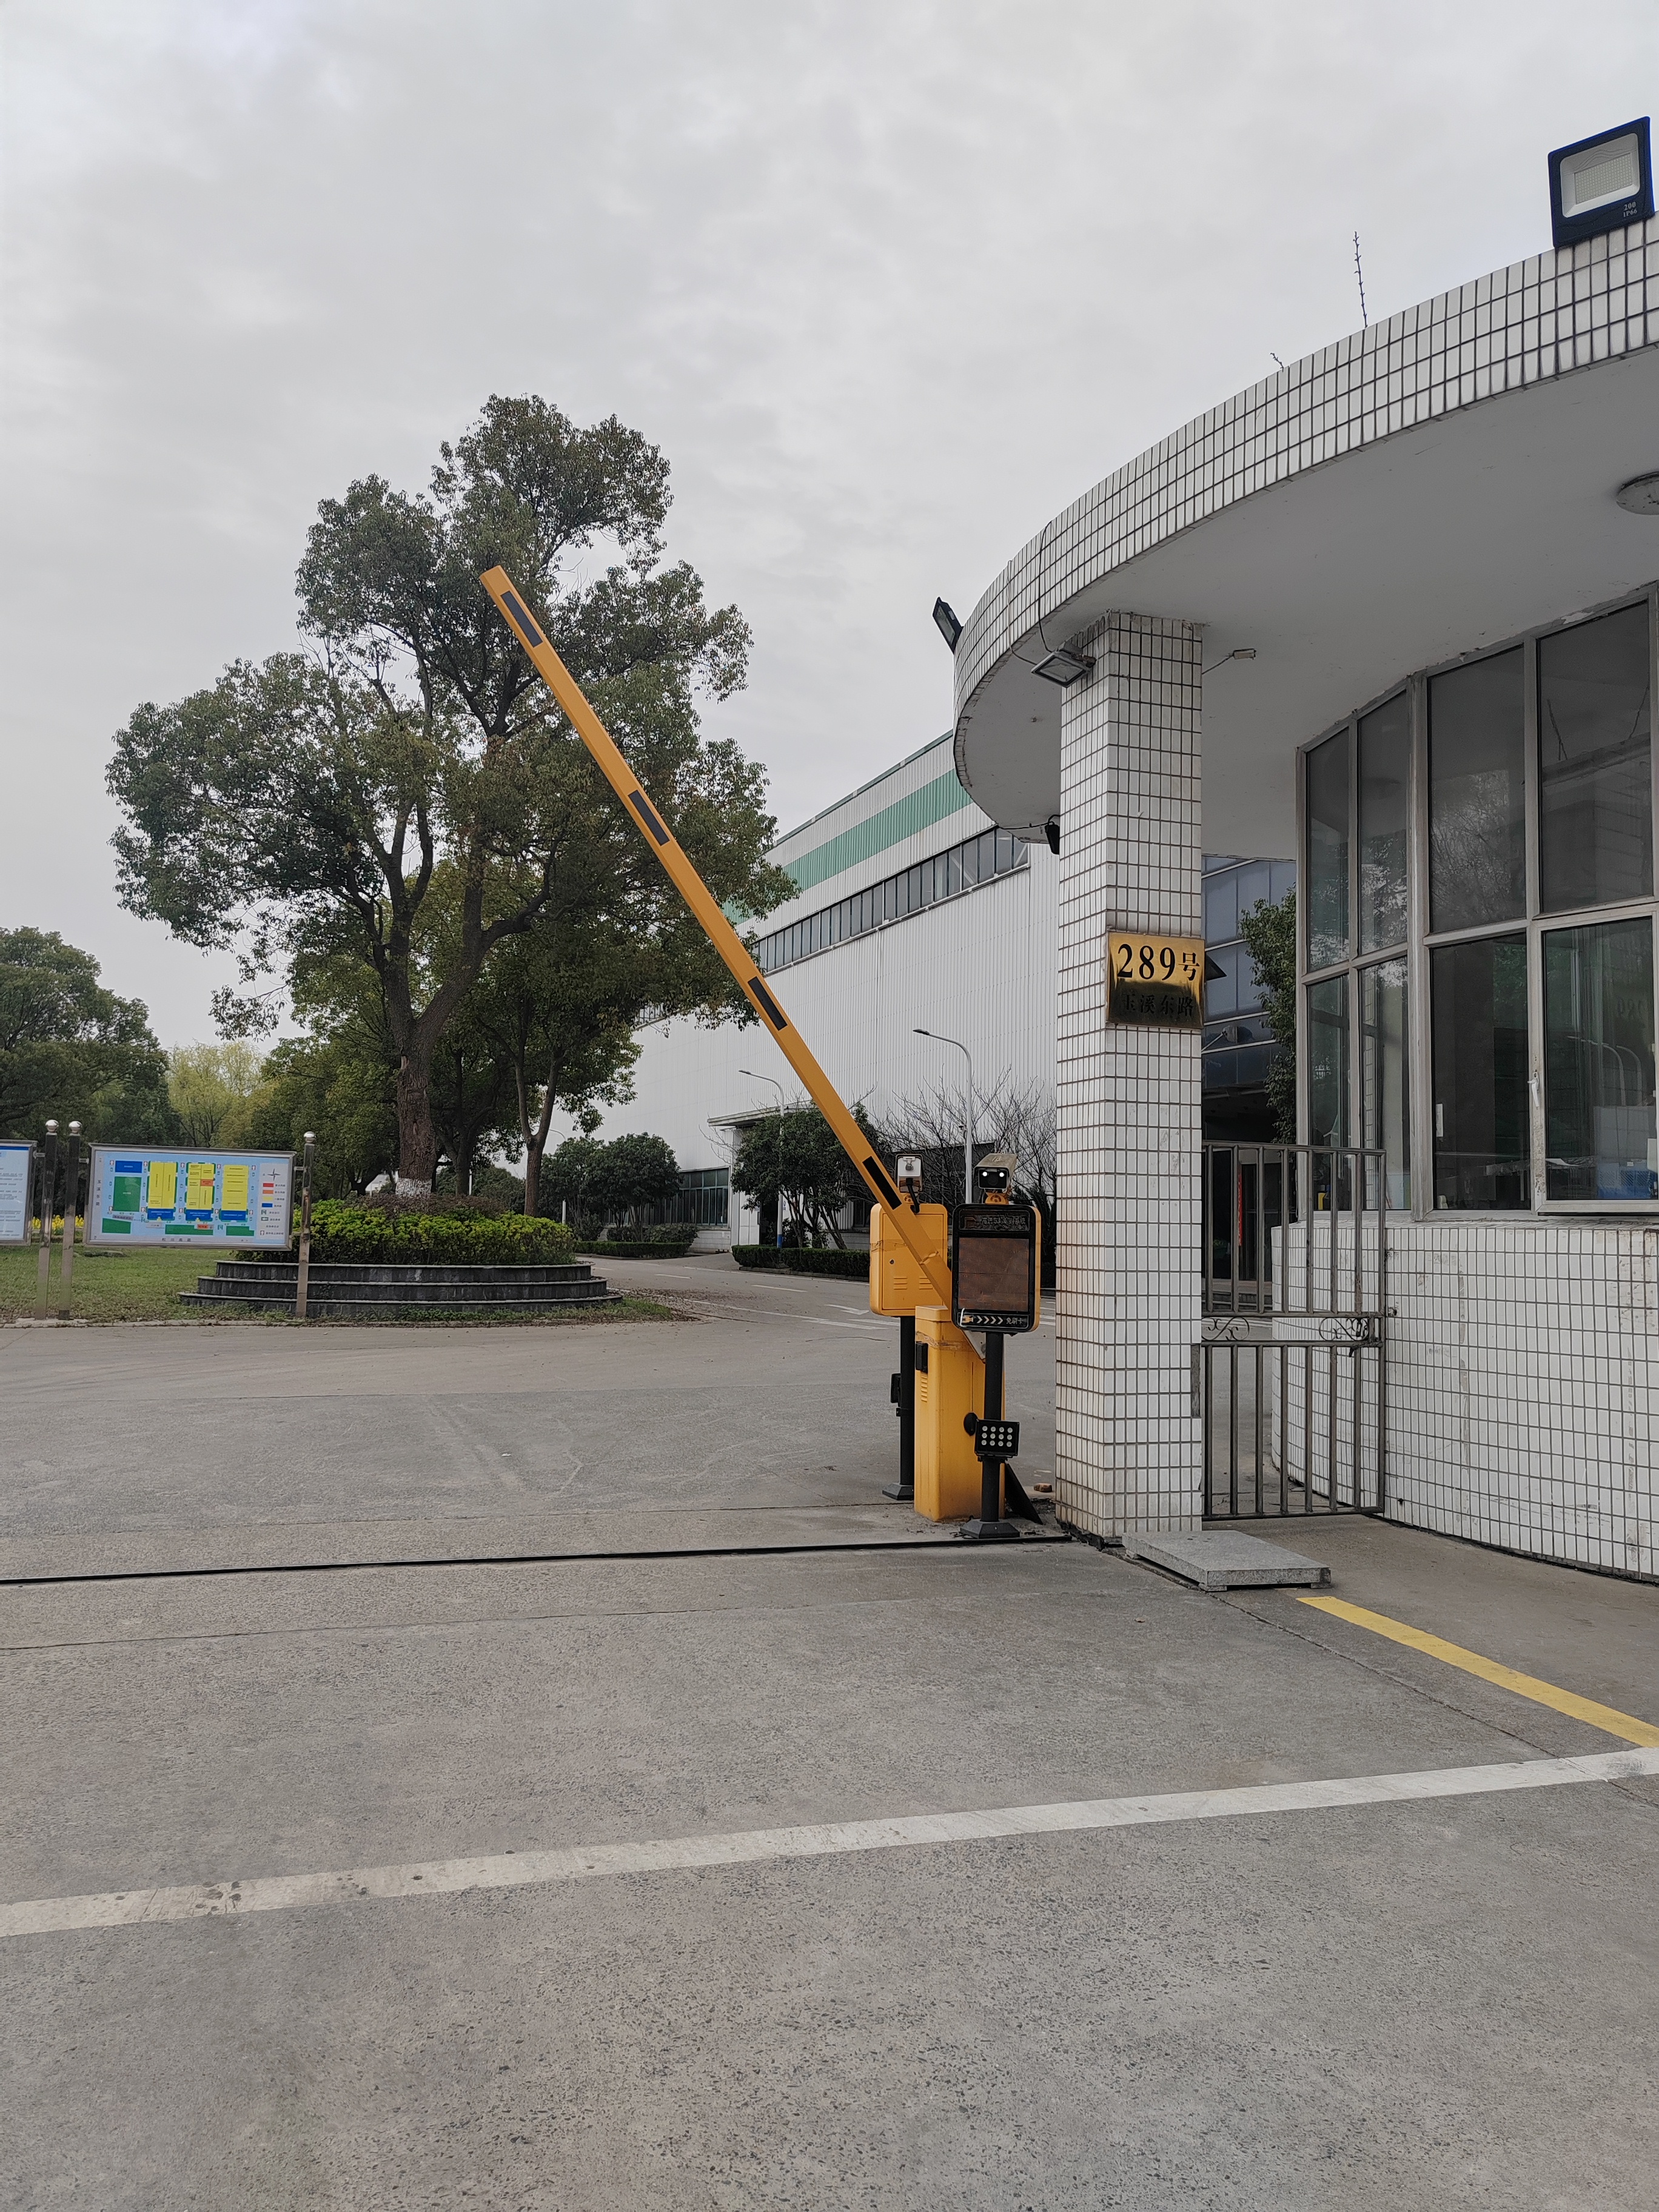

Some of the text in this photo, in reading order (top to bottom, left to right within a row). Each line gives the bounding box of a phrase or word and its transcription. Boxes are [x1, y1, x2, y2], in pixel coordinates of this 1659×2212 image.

[1624, 201, 1636, 211] 200
[1623, 209, 1637, 218] IP66
[1117, 943, 1201, 981] 289号
[1006, 1317, 1024, 1326] 免刷卡
